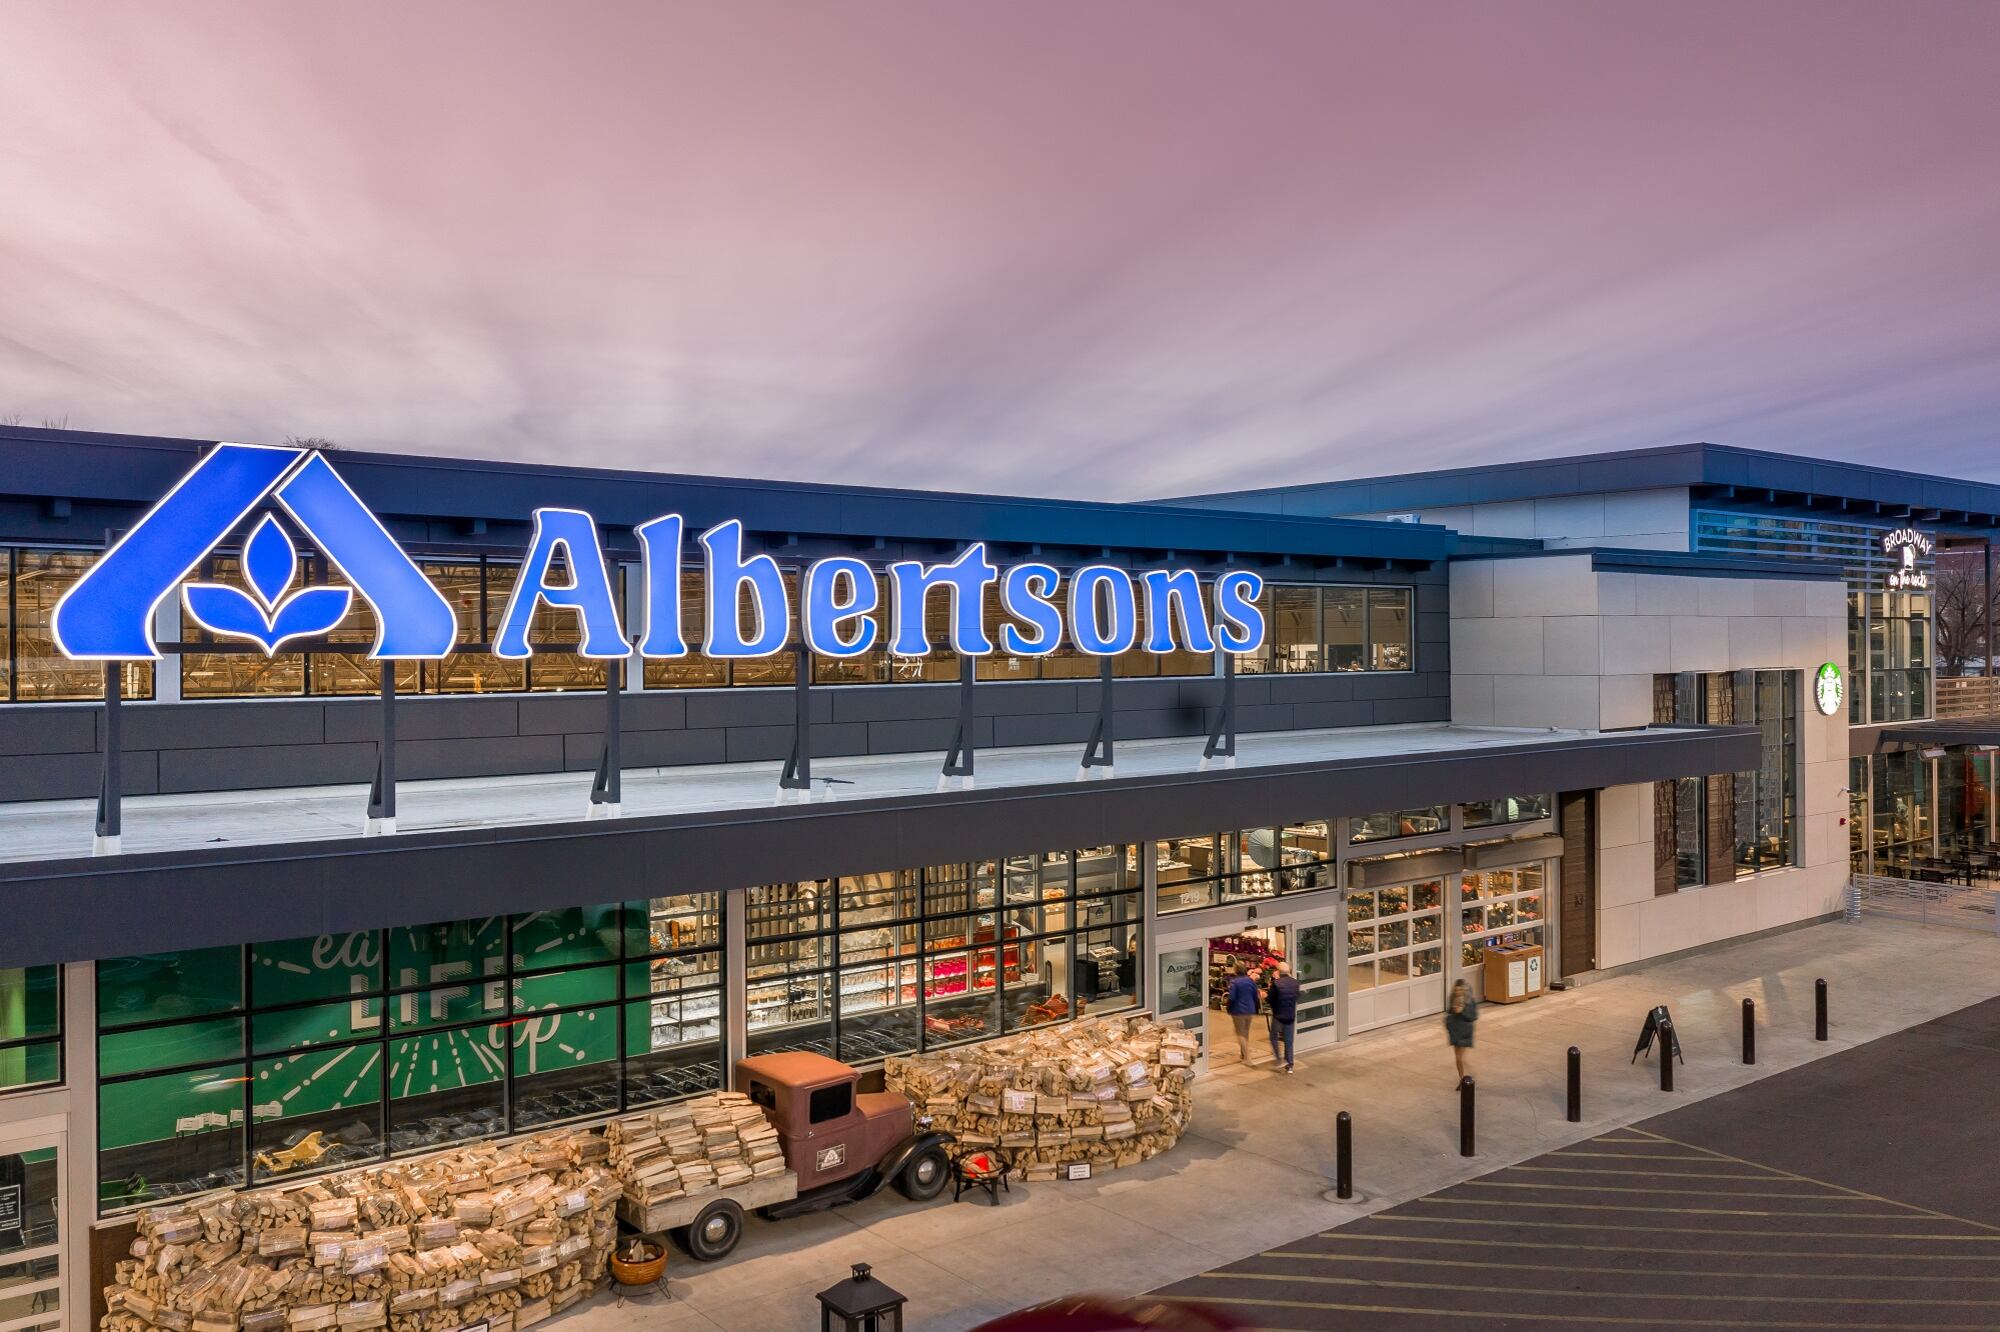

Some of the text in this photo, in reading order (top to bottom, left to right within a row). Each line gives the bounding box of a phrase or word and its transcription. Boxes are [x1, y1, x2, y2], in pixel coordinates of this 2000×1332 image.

[1884, 528, 1932, 555] BROADWAY
[492, 507, 1265, 658] Albertsons
[1179, 890, 1200, 905] 1219
[311, 930, 381, 969] ea
[351, 954, 523, 1031] LIFE
